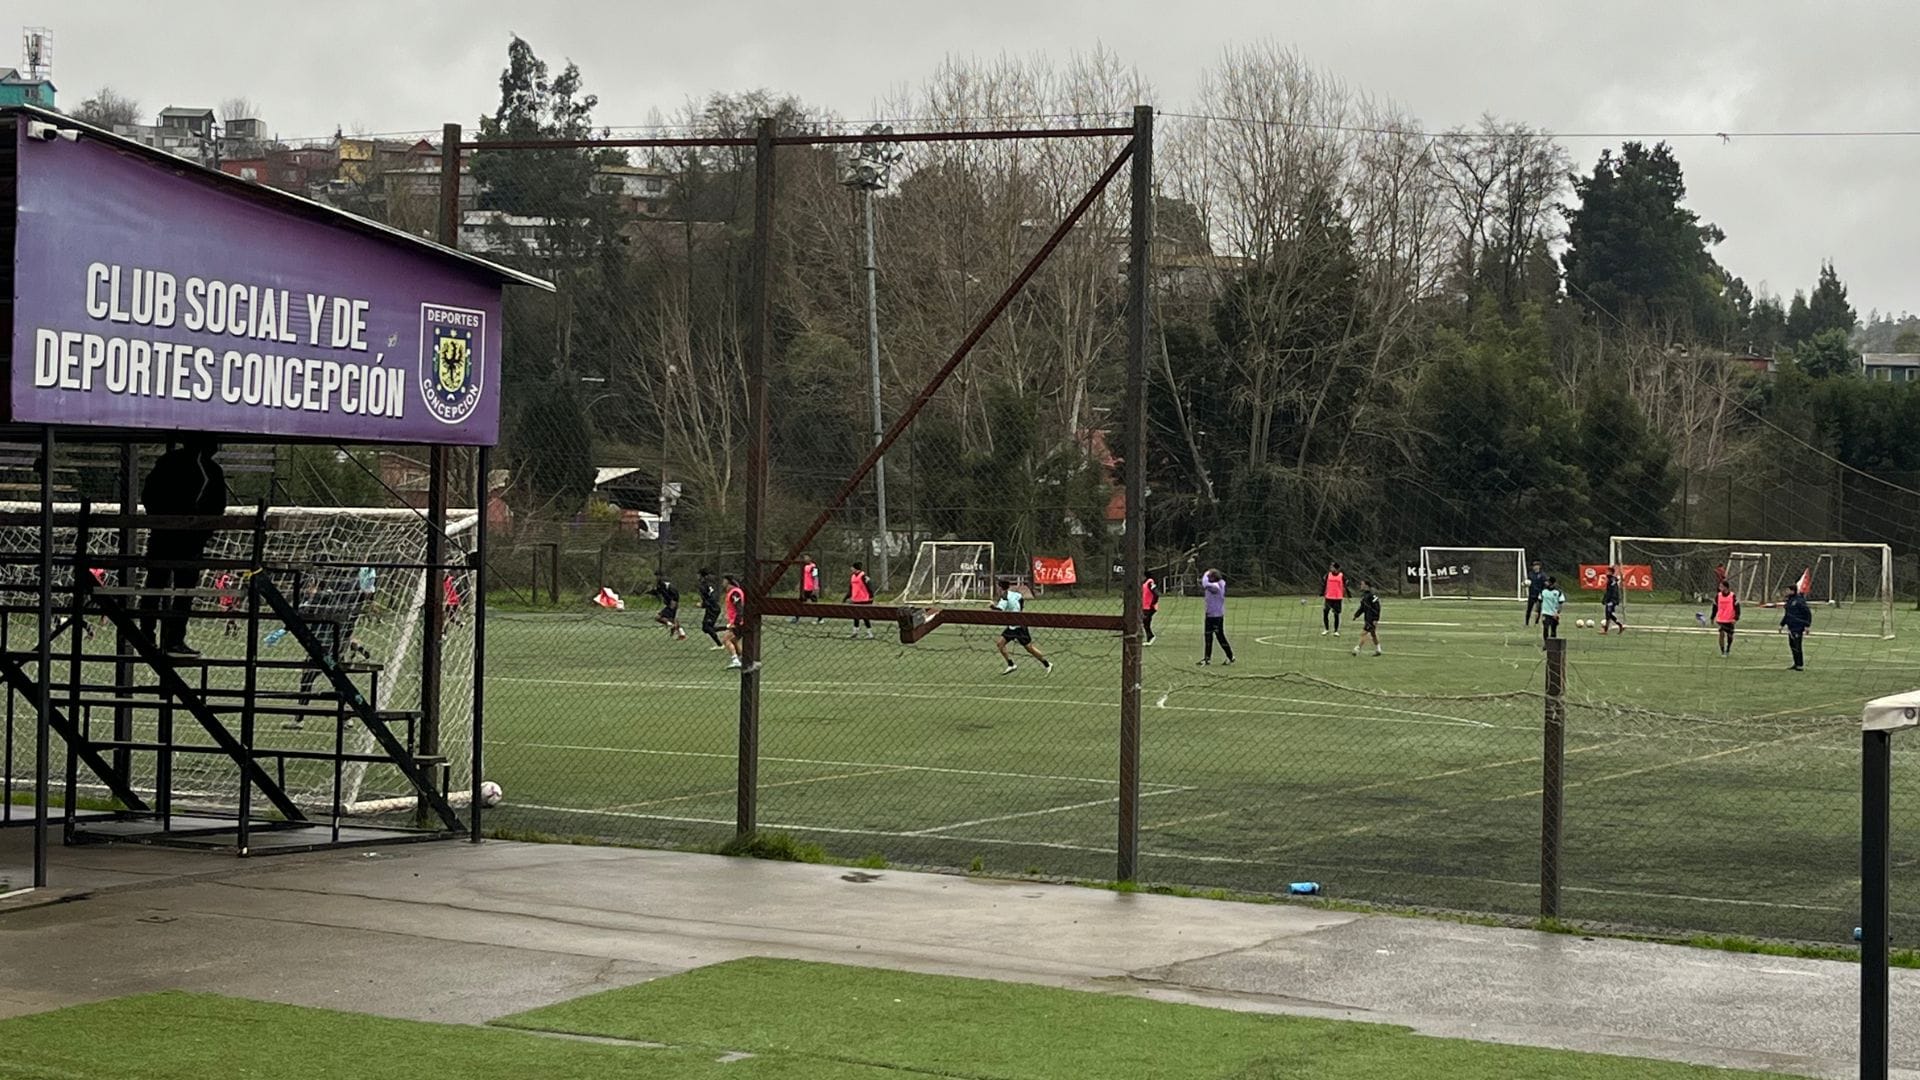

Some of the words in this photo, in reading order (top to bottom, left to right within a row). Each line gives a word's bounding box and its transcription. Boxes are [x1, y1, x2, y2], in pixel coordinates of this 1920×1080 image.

[86, 262, 177, 327] CLUB
[184, 277, 297, 342] SOCIAL
[307, 293, 326, 345] Y
[332, 297, 369, 350] DE
[427, 309, 479, 327] DEPORTES
[34, 328, 215, 401] DEPORTES
[221, 350, 405, 418] CONCEPCIÓN
[1407, 565, 1458, 577] KELME
